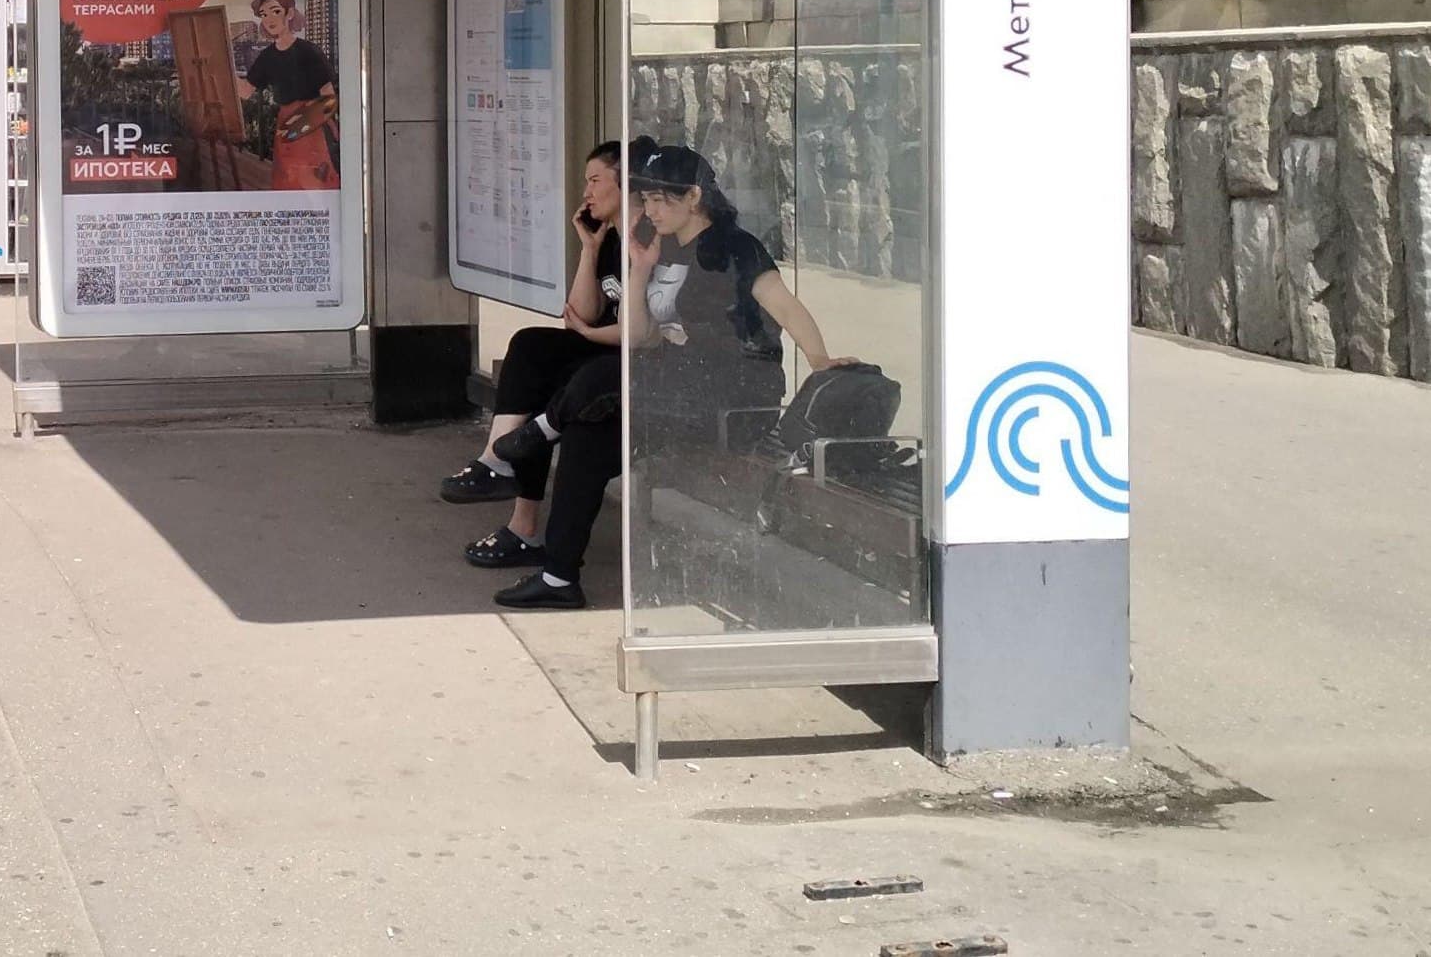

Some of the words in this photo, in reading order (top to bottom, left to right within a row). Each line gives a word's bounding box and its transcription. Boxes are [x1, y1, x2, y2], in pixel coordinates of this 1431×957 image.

[73, 4, 155, 16] ТЕРРАСАМИ
[74, 145, 94, 156] ЗА
[74, 160, 174, 178] ИПОТЕКА
